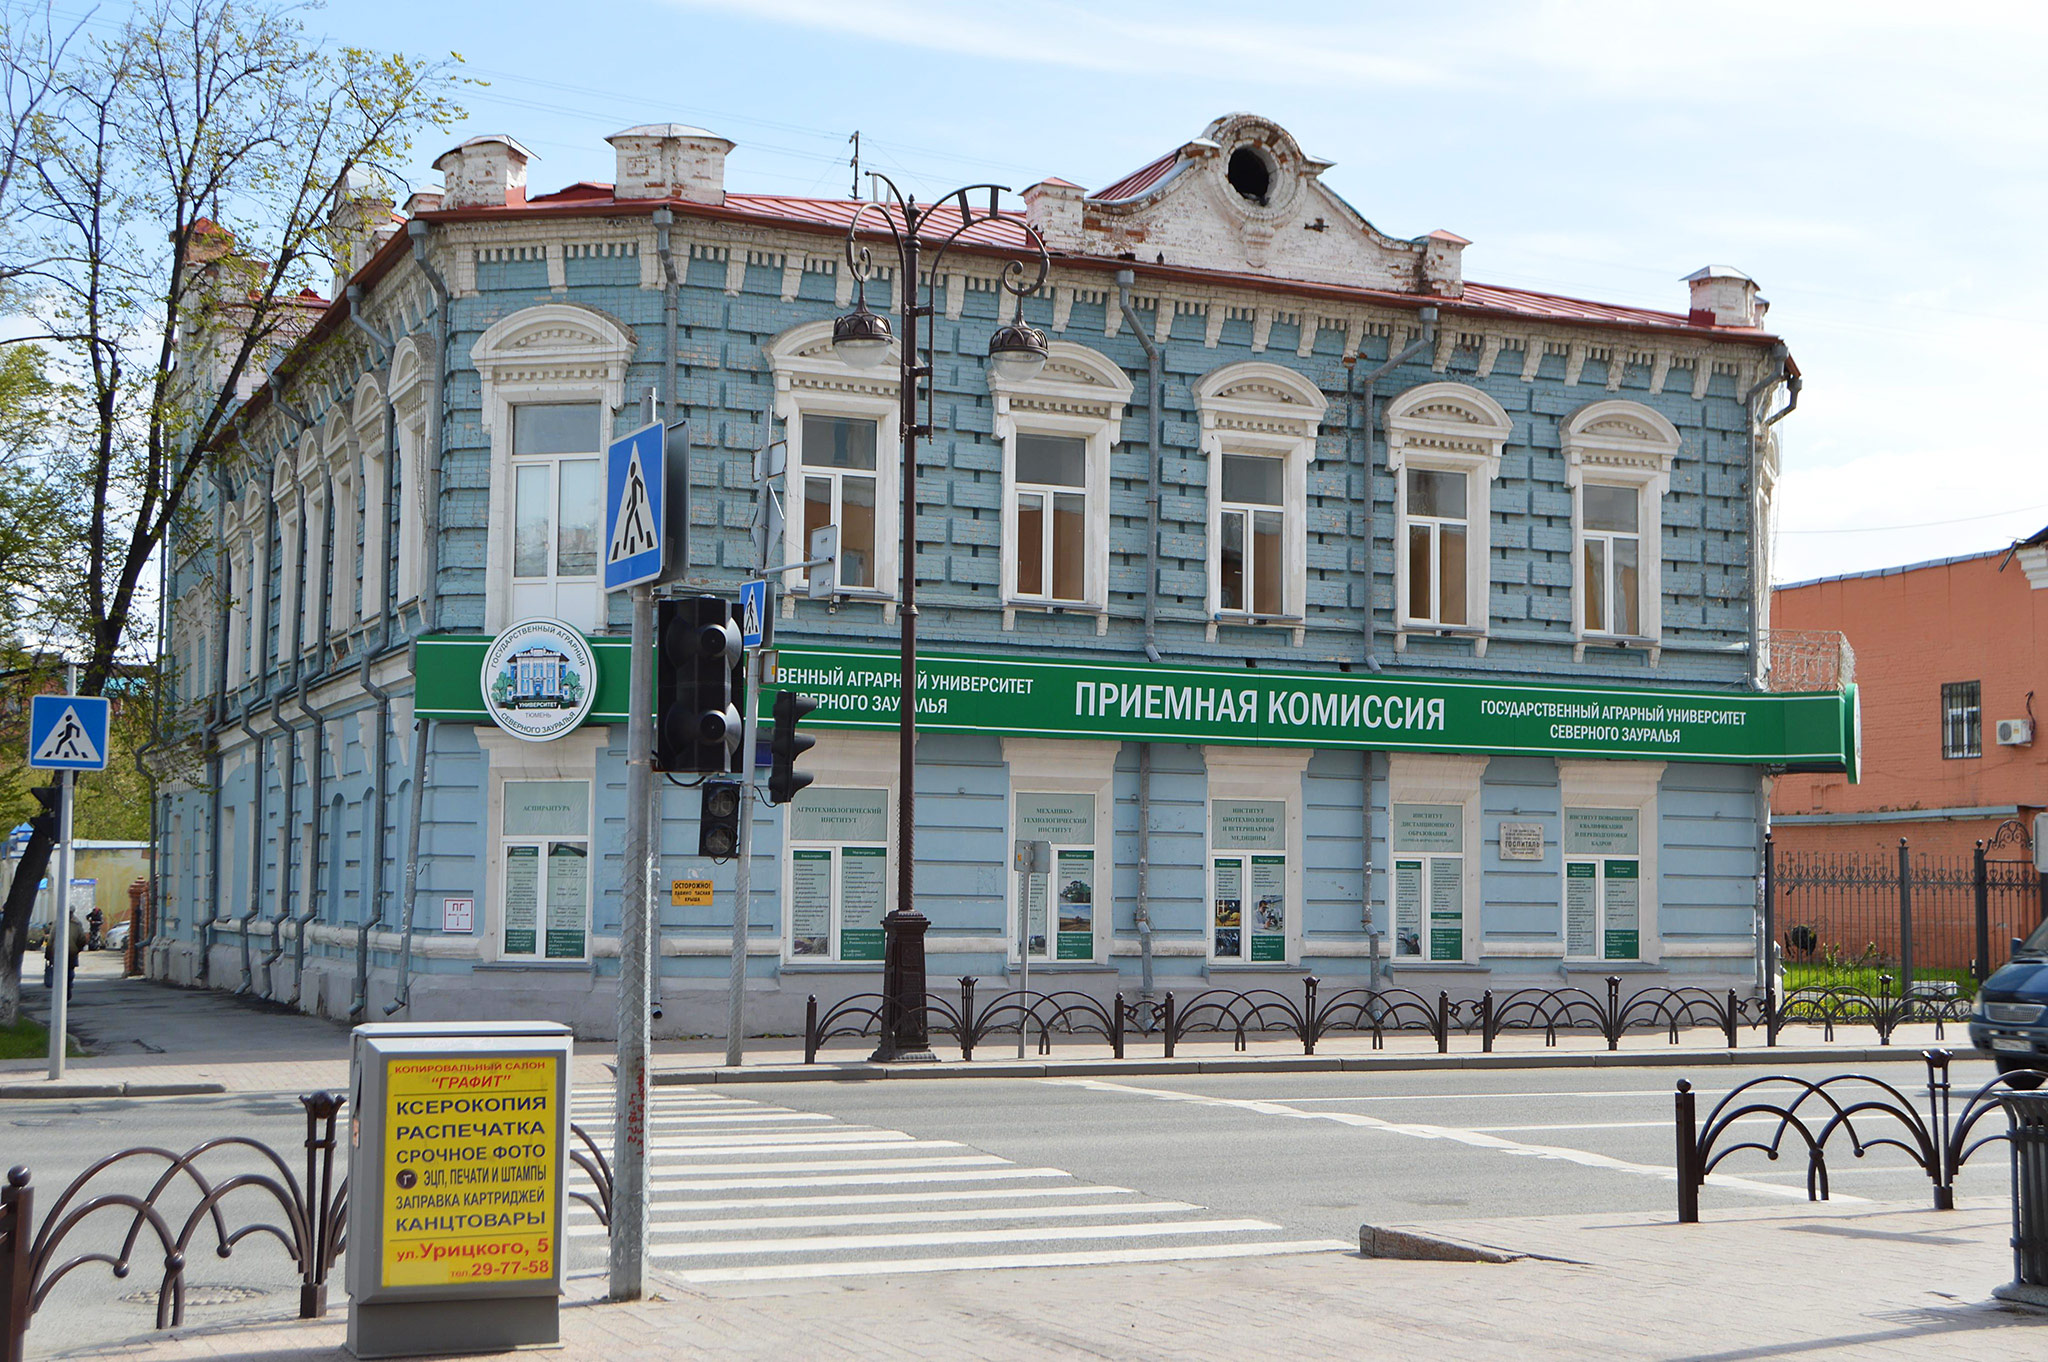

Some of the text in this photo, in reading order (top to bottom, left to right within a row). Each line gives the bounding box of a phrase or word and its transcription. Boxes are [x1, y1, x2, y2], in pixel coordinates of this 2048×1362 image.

[491, 625, 586, 668] ГОСУДАРСТВЕННЫЙ АГРАРНЫЙ
[777, 666, 1034, 694] ВЕННЫЙ АГРАРНЙ УНИВЕРСИТЕТ
[872, 694, 948, 714] ЗАУЛЬЯ
[1075, 681, 1445, 731] ПРИЕМНАЯ КОМИССИЯ
[1481, 700, 1747, 726] ГОСУДАРСТВЕННЫЙ АГРАРНЫЙ УНИВЕРСИТЕТ
[501, 711, 577, 733] СЕВЕРНОГО ЗАУРАЛЬЯ
[1550, 724, 1681, 743] СЕВЕРНОГО ЗАУРАЛЬЯ
[797, 806, 882, 814] АГРОТЕХНОЛОГИЧЕСКИЙ
[1505, 840, 1540, 848] ГОСПИТАЛЬ
[452, 903, 465, 911] ПГ
[395, 1062, 546, 1074] КОПИРОВАЛЬНЫЙ САЛОН
[397, 1097, 546, 1115] КСЕРОКОПИЯ
[397, 1121, 545, 1140] РАСПЕЧАТКА
[396, 1144, 546, 1164] СРОЧНОЕ ФОТО
[423, 1165, 546, 1188] ЭЦП, ПЕЧАТИ И ШТАМПЫ
[396, 1186, 545, 1210] ЗАПРАВКА КАРТРИДЖЕЙ
[396, 1211, 545, 1232] КАНЦТОВАРЫ
[537, 1238, 549, 1253] 5
